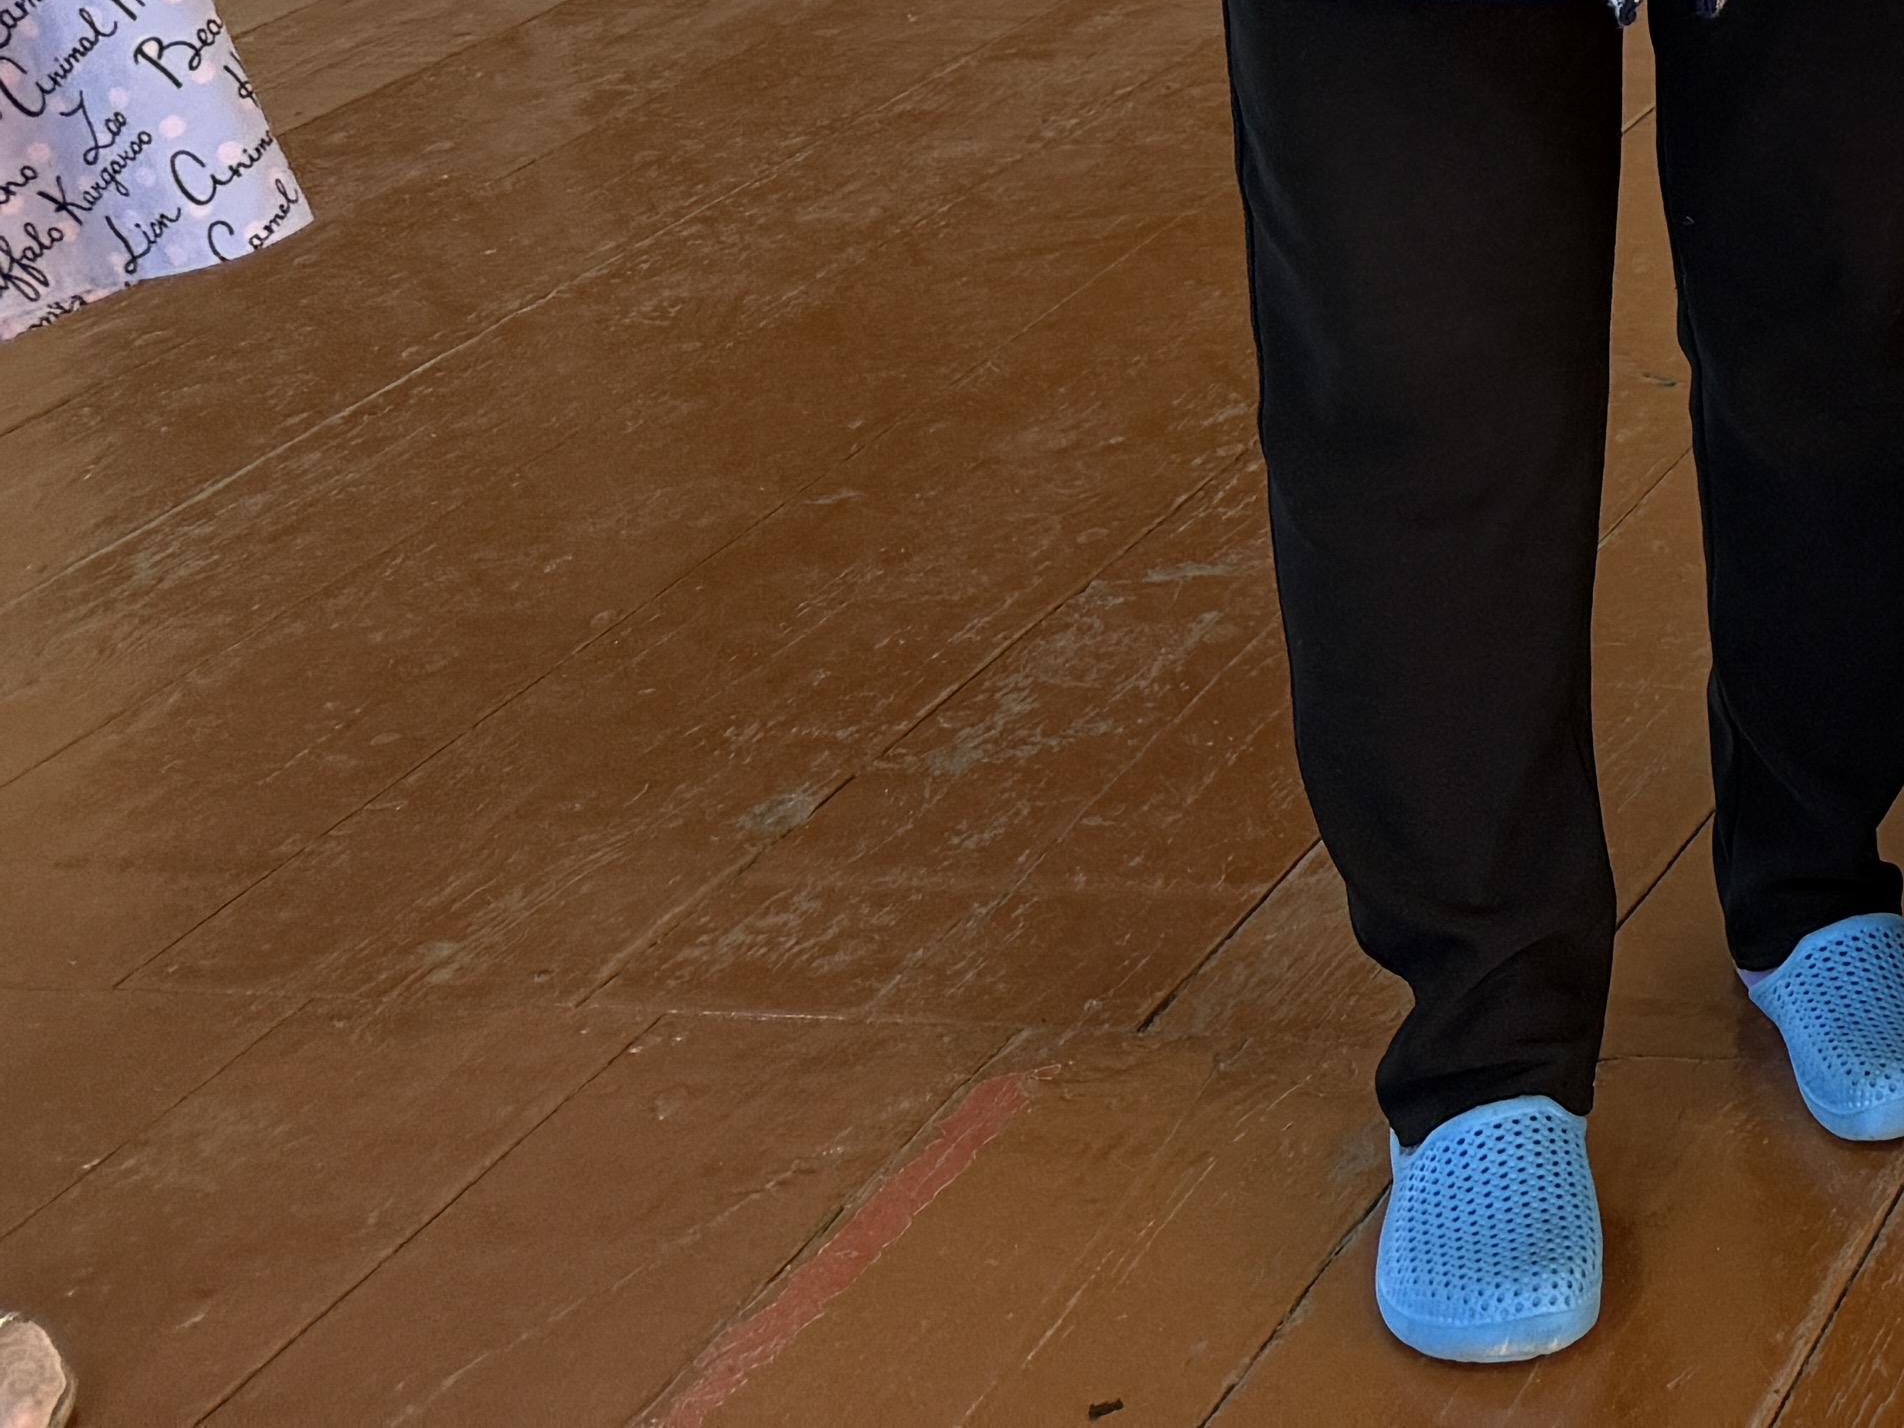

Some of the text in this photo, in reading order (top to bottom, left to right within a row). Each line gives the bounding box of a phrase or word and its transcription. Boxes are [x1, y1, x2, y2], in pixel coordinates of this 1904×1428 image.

[59, 90, 127, 166] Zoo
[38, 130, 152, 226] Kangaroo
[105, 206, 181, 275] Lion
